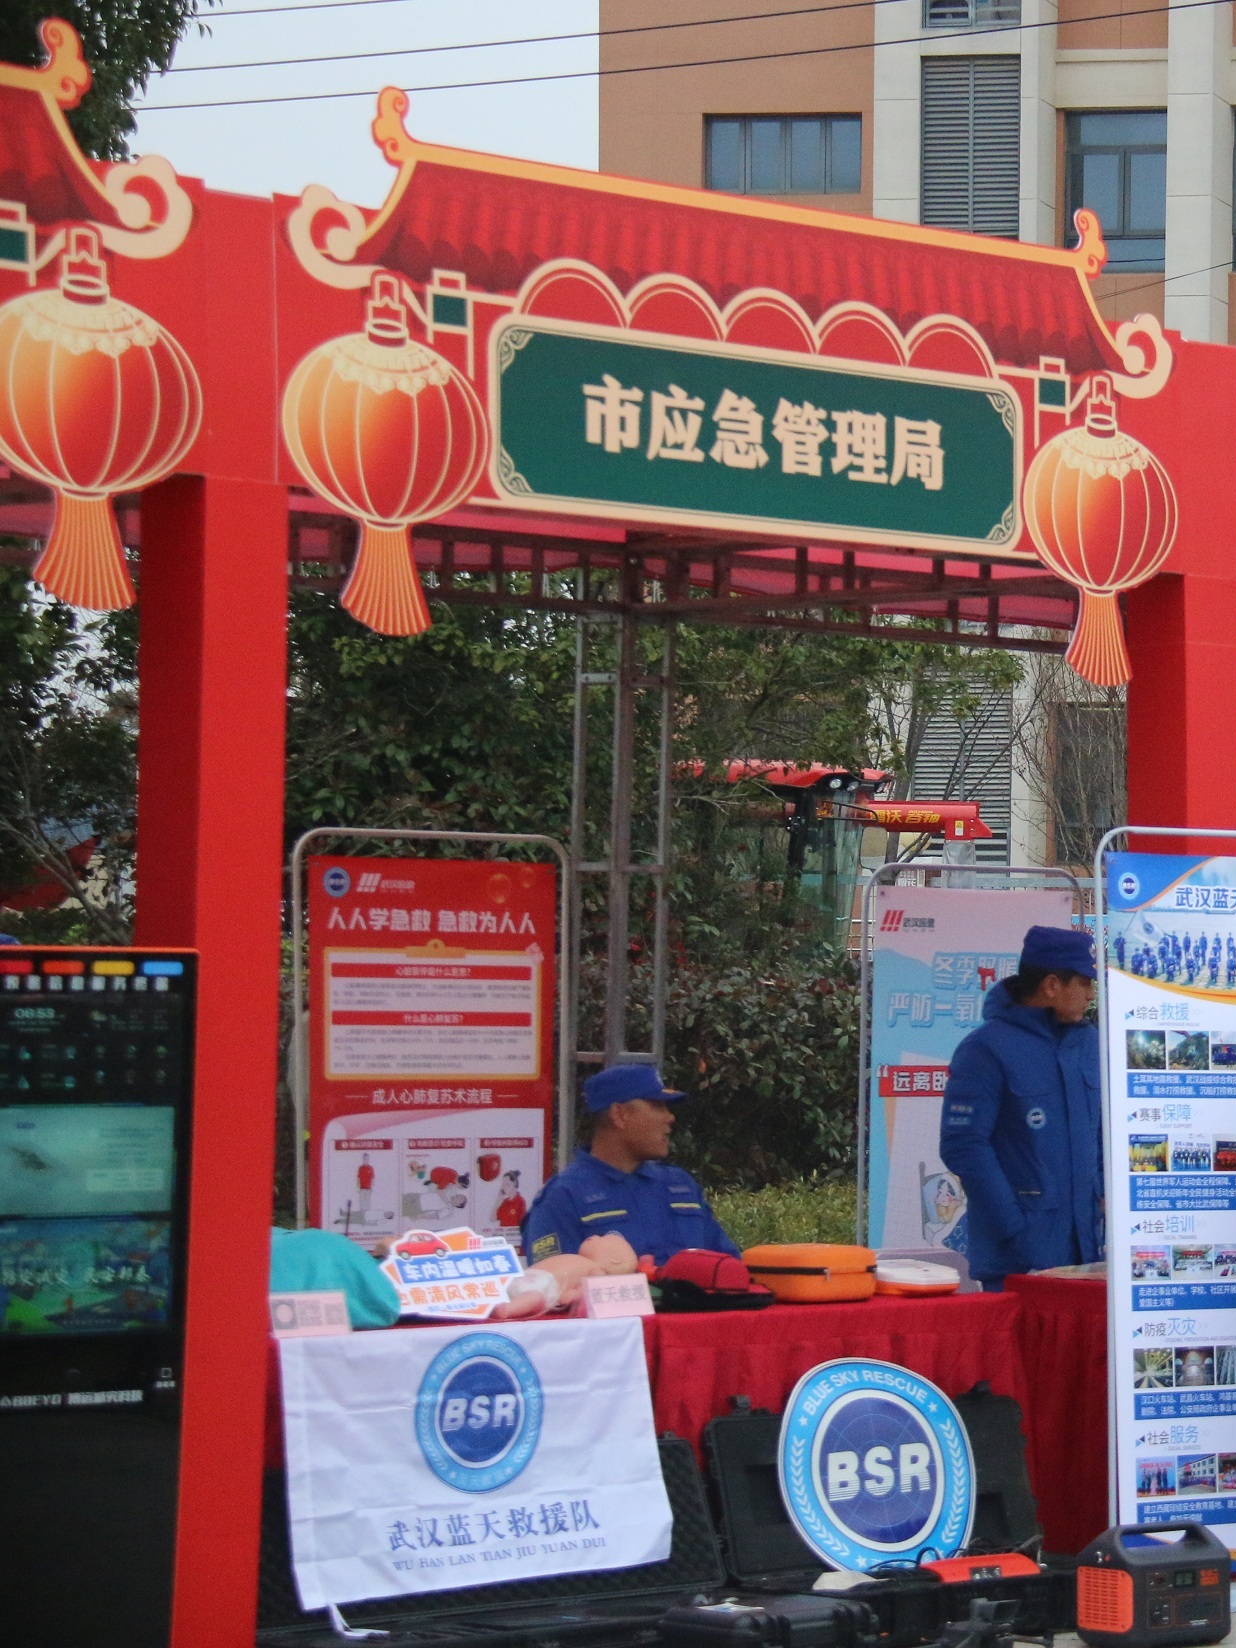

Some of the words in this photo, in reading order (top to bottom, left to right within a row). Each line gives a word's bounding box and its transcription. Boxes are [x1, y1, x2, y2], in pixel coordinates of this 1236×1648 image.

[582, 373, 945, 491] 市应急管理局
[327, 906, 432, 933] 人人学急救
[437, 909, 537, 935] 急救为人人
[888, 992, 984, 1022] 严防一氧
[1136, 1002, 1190, 1021] 综合救援
[1139, 1104, 1192, 1122] 赛事保障
[1142, 1215, 1195, 1234] 社会培训
[403, 1254, 511, 1281] 车内温暖如春
[1144, 1317, 1197, 1336] 防疫灭灾
[802, 1379, 835, 1416] BLUE
[829, 1369, 860, 1388] SKY
[861, 1369, 928, 1404] RESCUE
[441, 1393, 518, 1432] BSR
[1147, 1425, 1200, 1446] 社会服务
[827, 1442, 931, 1502] BSR
[386, 1499, 600, 1551] 武汉蓝天救援队
[392, 1560, 415, 1571] WU
[419, 1556, 444, 1569] HAN
[449, 1553, 477, 1566] LAN
[480, 1548, 513, 1562] TIAN
[516, 1545, 537, 1560] JIU
[541, 1540, 579, 1555] YUAN
[582, 1536, 607, 1549] DUI
